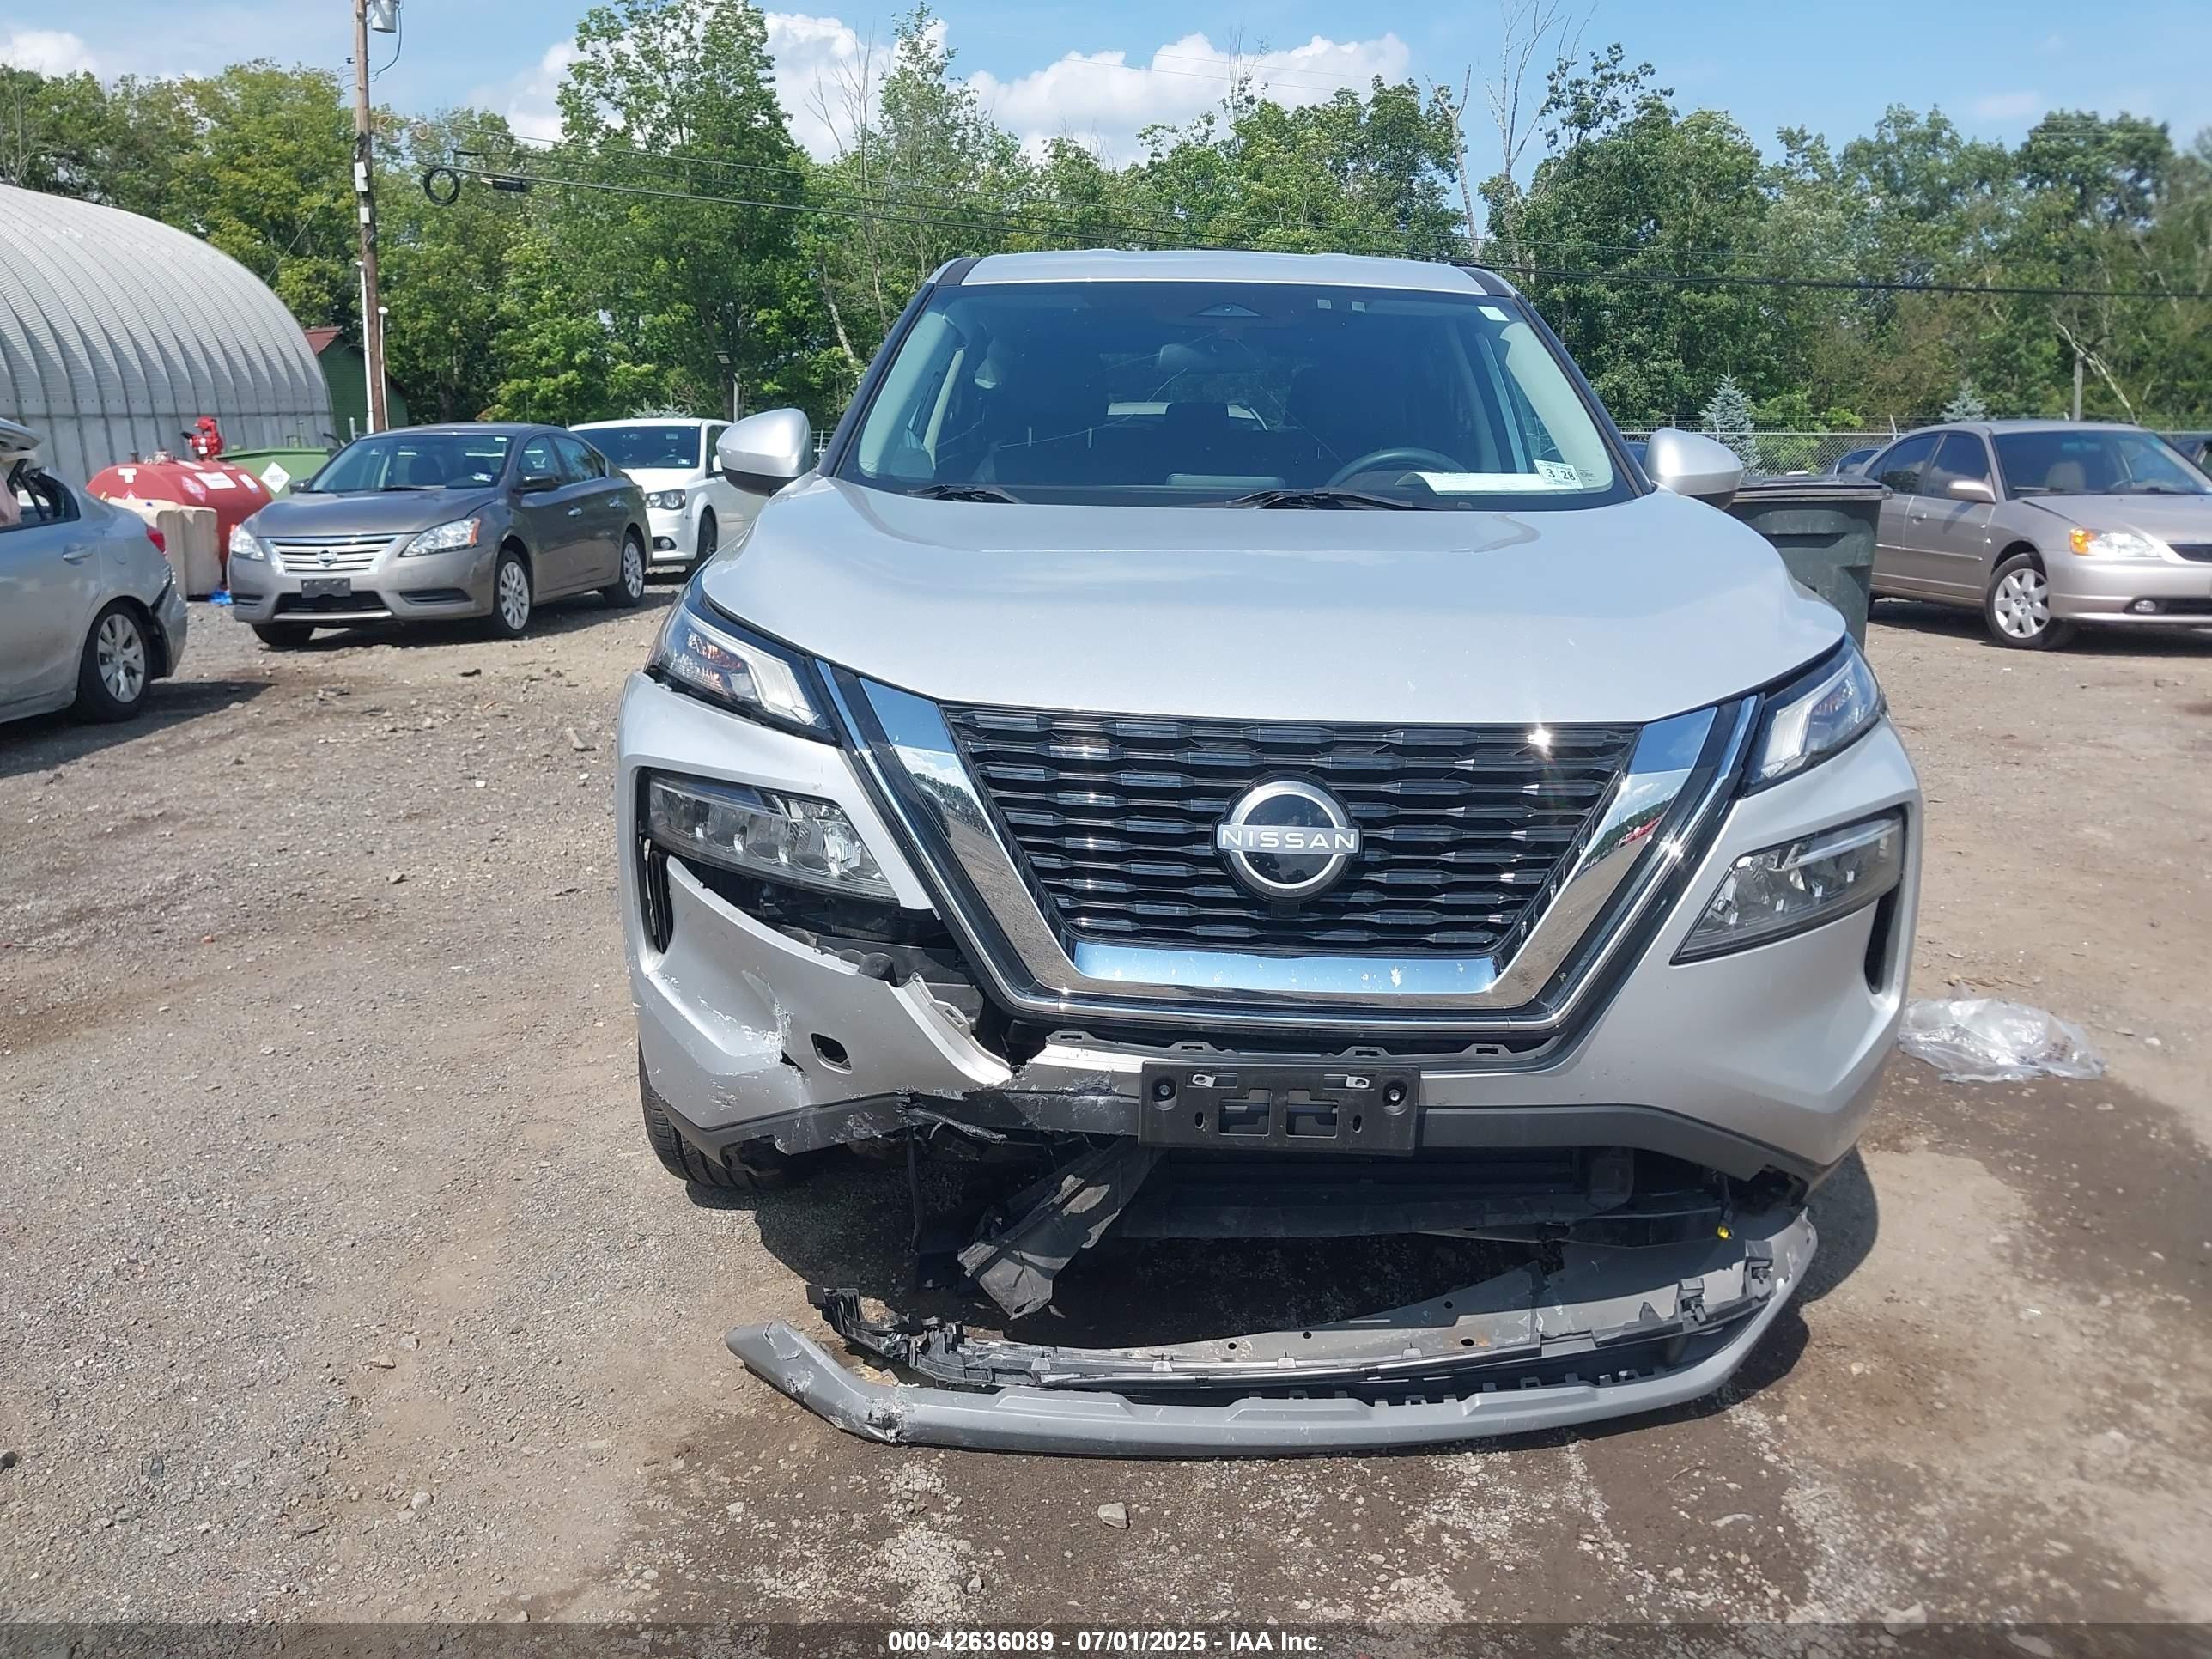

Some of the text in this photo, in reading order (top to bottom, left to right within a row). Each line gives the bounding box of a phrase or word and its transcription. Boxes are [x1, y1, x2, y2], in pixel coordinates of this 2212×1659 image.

[1546, 468, 1556, 478] 3
[1560, 470, 1576, 481] 28
[1222, 830, 1355, 850] NISSAN
